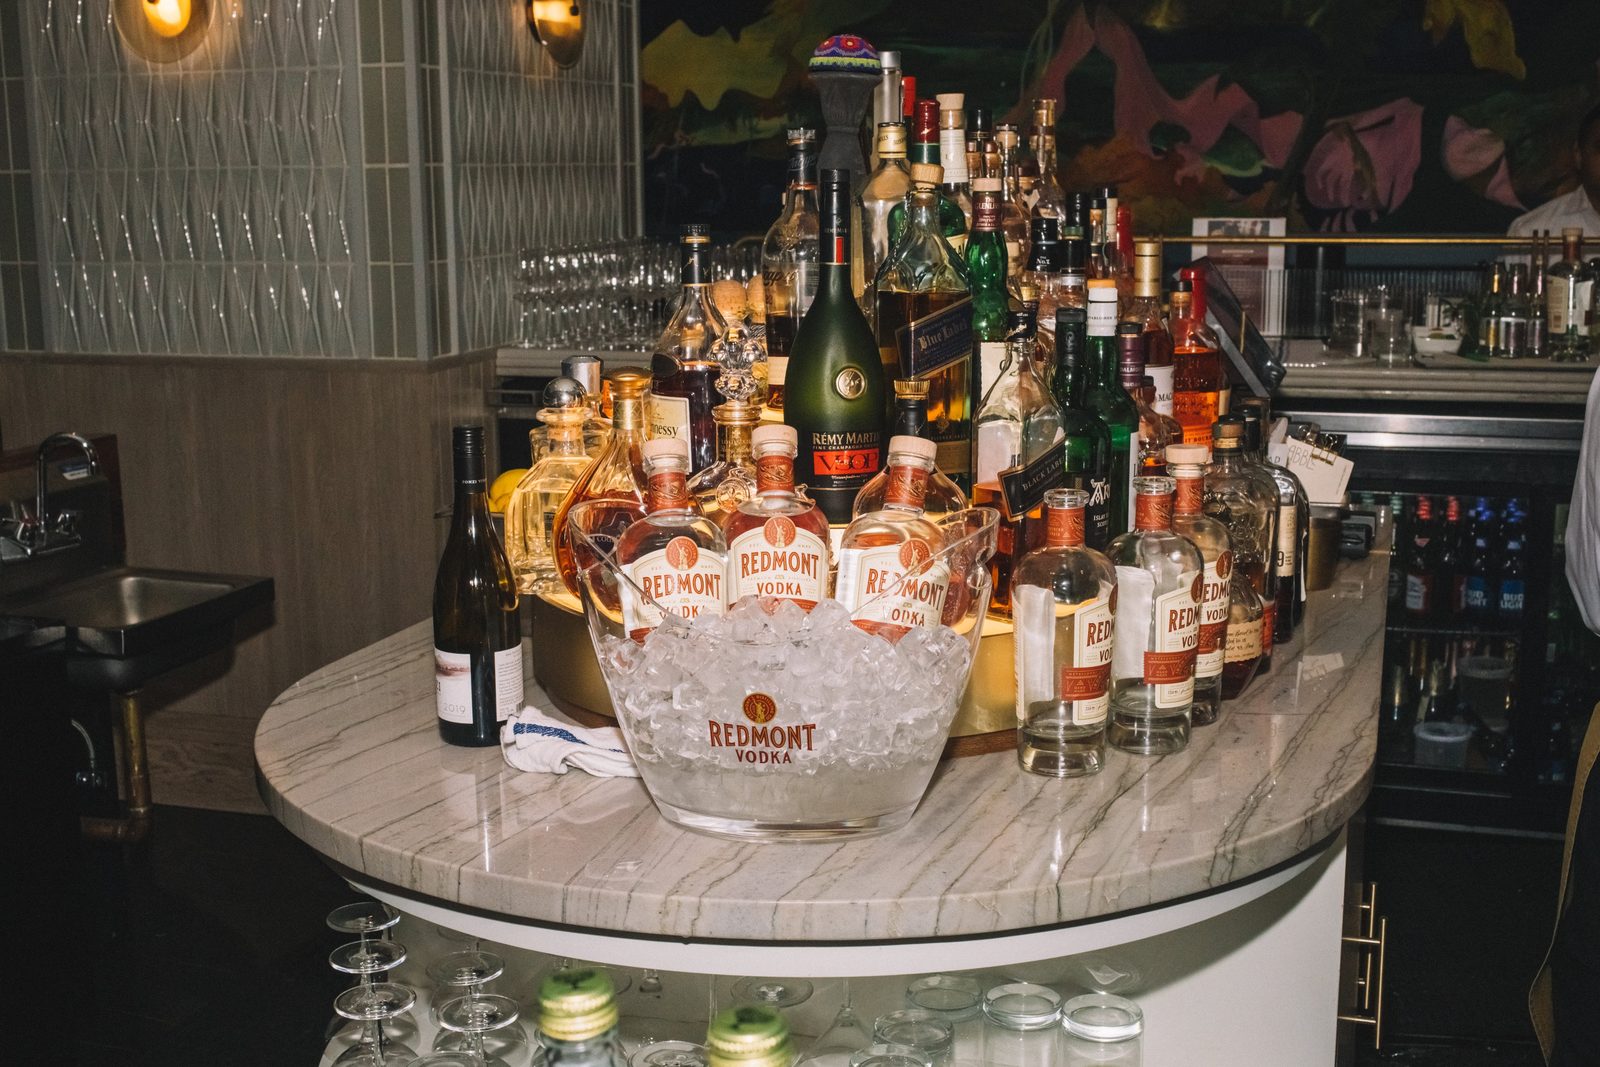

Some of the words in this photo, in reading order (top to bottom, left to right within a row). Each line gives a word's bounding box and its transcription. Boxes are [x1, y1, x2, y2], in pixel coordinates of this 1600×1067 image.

[918, 332, 942, 352] Blue
[812, 432, 844, 446] RÉMY
[1022, 470, 1046, 491] BLACK
[741, 550, 819, 580] REDMONT
[641, 573, 721, 606] REDMONT
[757, 582, 802, 596] VODKA
[866, 568, 945, 612] REDMONT
[708, 720, 817, 752] REDMONT
[735, 749, 792, 765] VODKA
